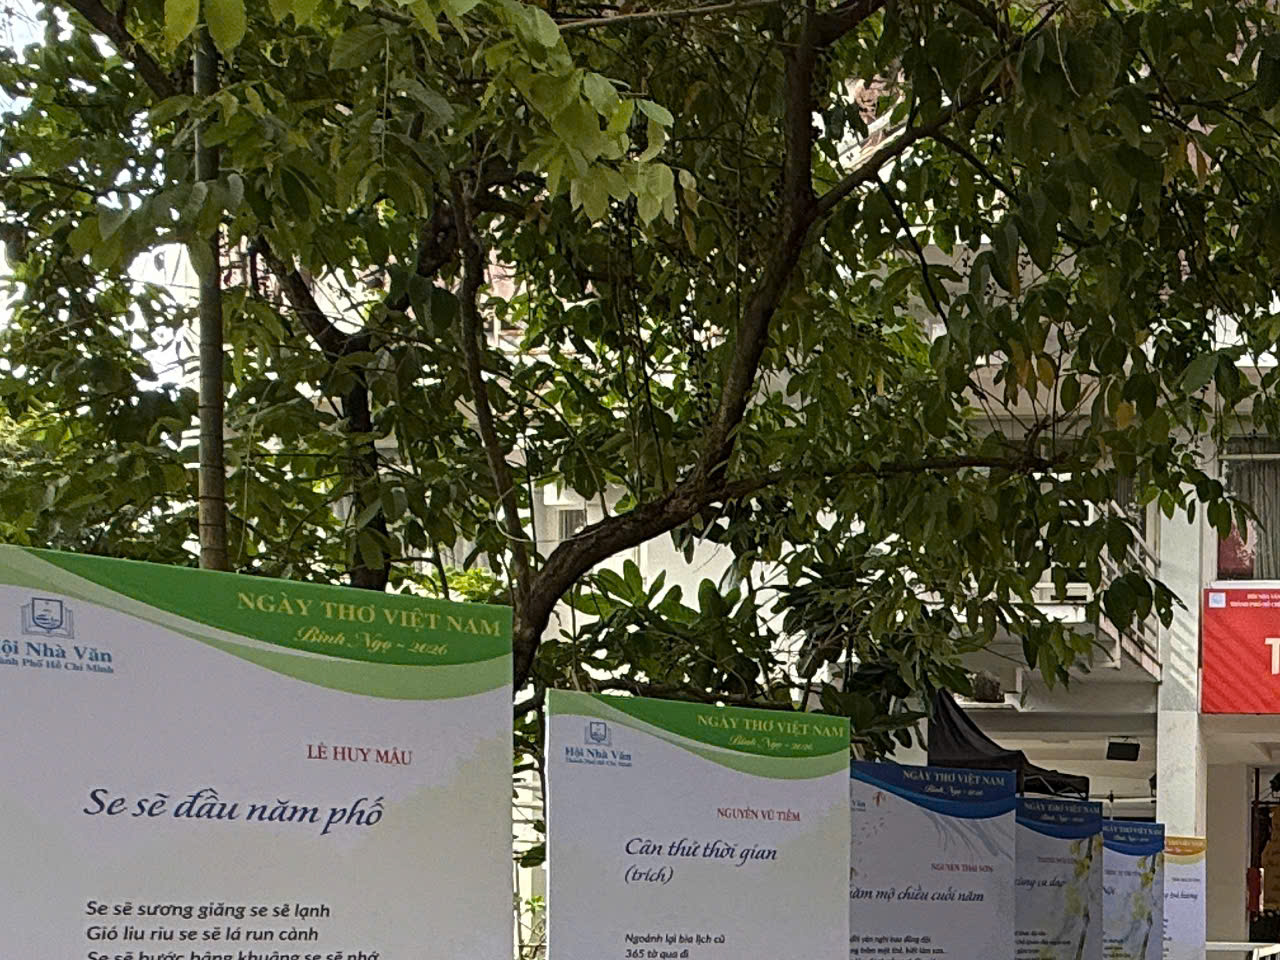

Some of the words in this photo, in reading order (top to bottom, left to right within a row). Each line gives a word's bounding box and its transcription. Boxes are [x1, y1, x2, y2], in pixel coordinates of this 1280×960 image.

[238, 592, 313, 615] NGÀY
[320, 601, 375, 623] THƠ
[382, 608, 440, 632] VIỆT
[447, 616, 500, 636] NAM
[0, 640, 18, 657] ội
[25, 642, 66, 658] Nhà
[74, 646, 112, 662] Văn
[84, 789, 127, 815] Se
[132, 793, 169, 817] sẽ
[174, 788, 239, 820] đầu
[246, 799, 321, 823] năm
[320, 797, 384, 835] phố
[626, 838, 662, 855] Cân
[668, 838, 700, 857] thử
[703, 840, 737, 858] thời
[736, 845, 776, 867] gian
[625, 864, 673, 885] (trích)
[86, 901, 108, 915] Se
[113, 902, 133, 915] sẽ
[137, 905, 194, 919] sương
[197, 903, 246, 919] giăng
[250, 907, 268, 917] se
[272, 904, 290, 917] sẽ
[295, 904, 329, 920] lạnh
